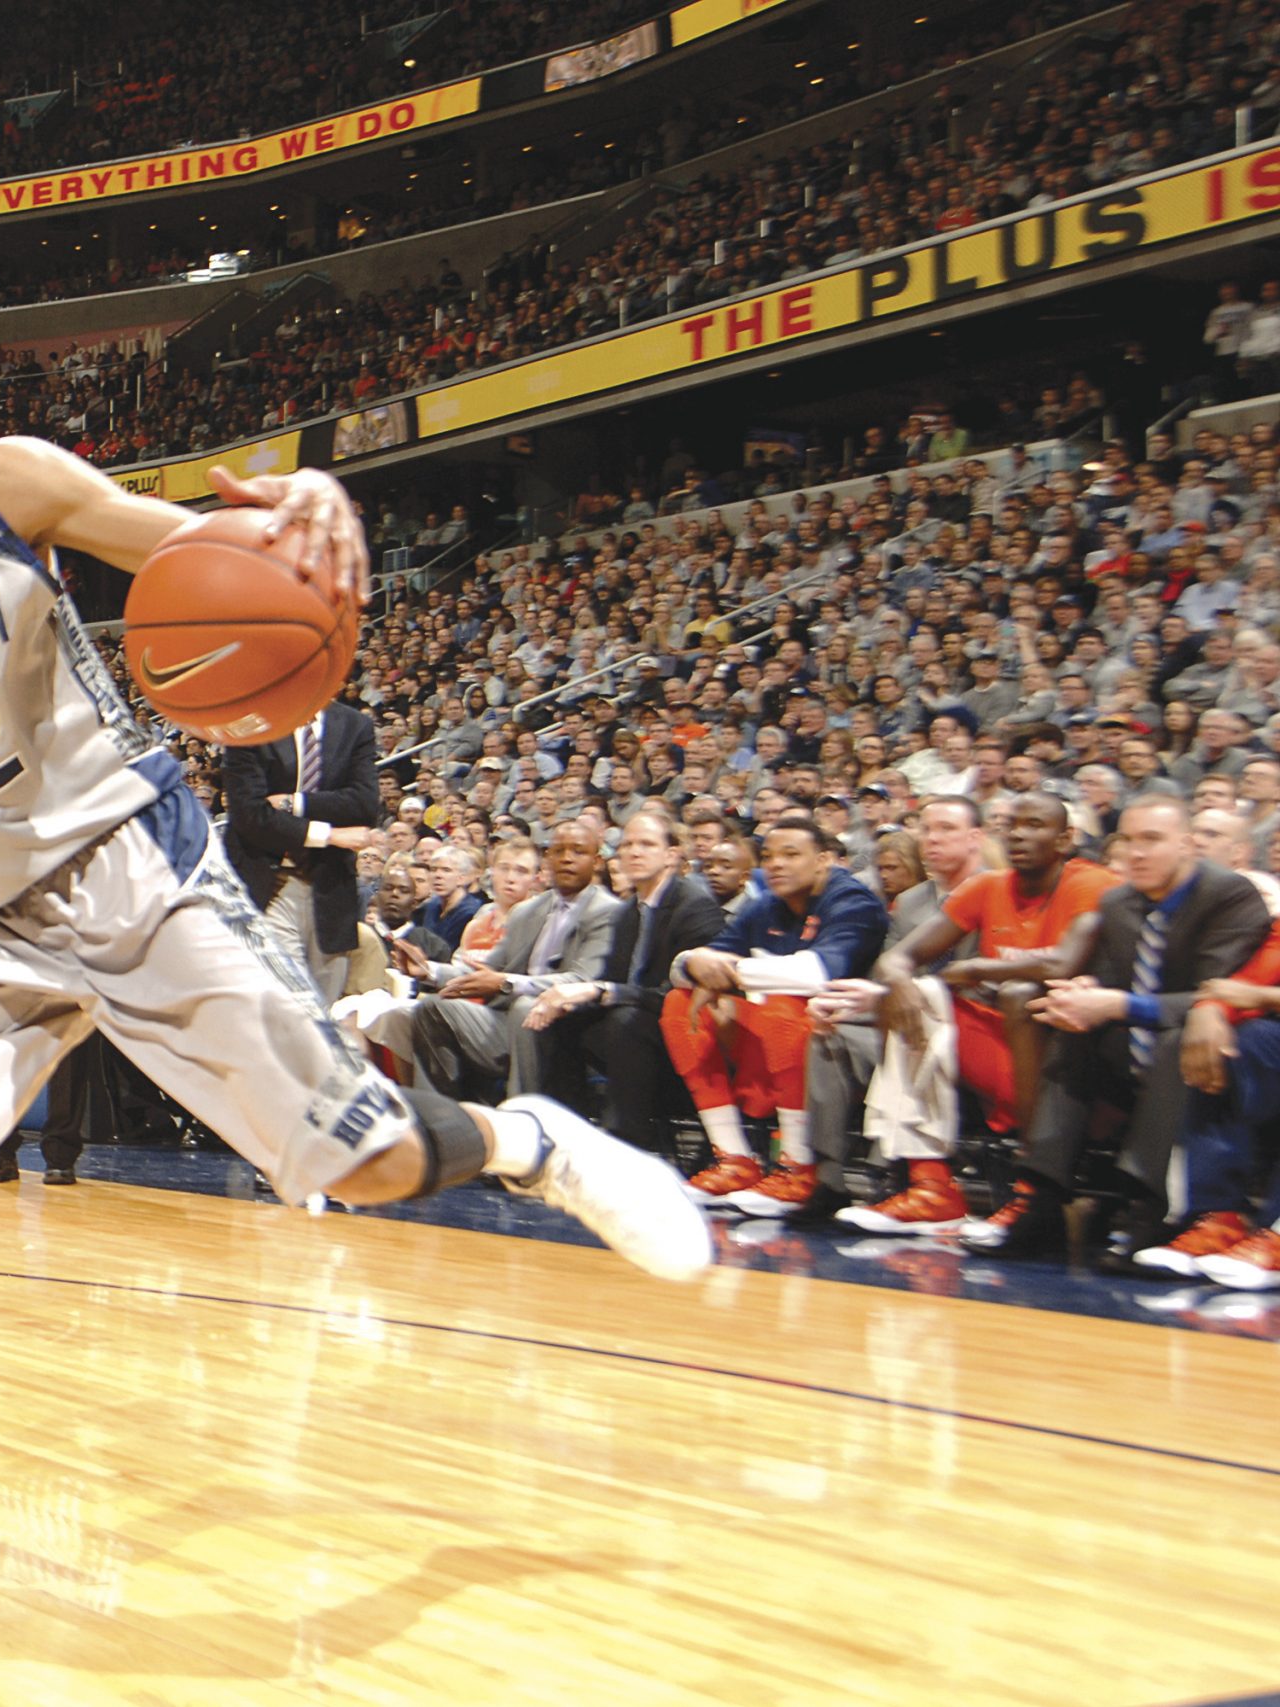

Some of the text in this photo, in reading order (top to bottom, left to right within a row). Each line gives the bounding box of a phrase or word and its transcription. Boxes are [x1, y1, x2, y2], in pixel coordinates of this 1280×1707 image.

[280, 124, 335, 161] WE
[357, 102, 416, 140] DO
[681, 285, 813, 362] THE
[859, 187, 1147, 322] PLUS
